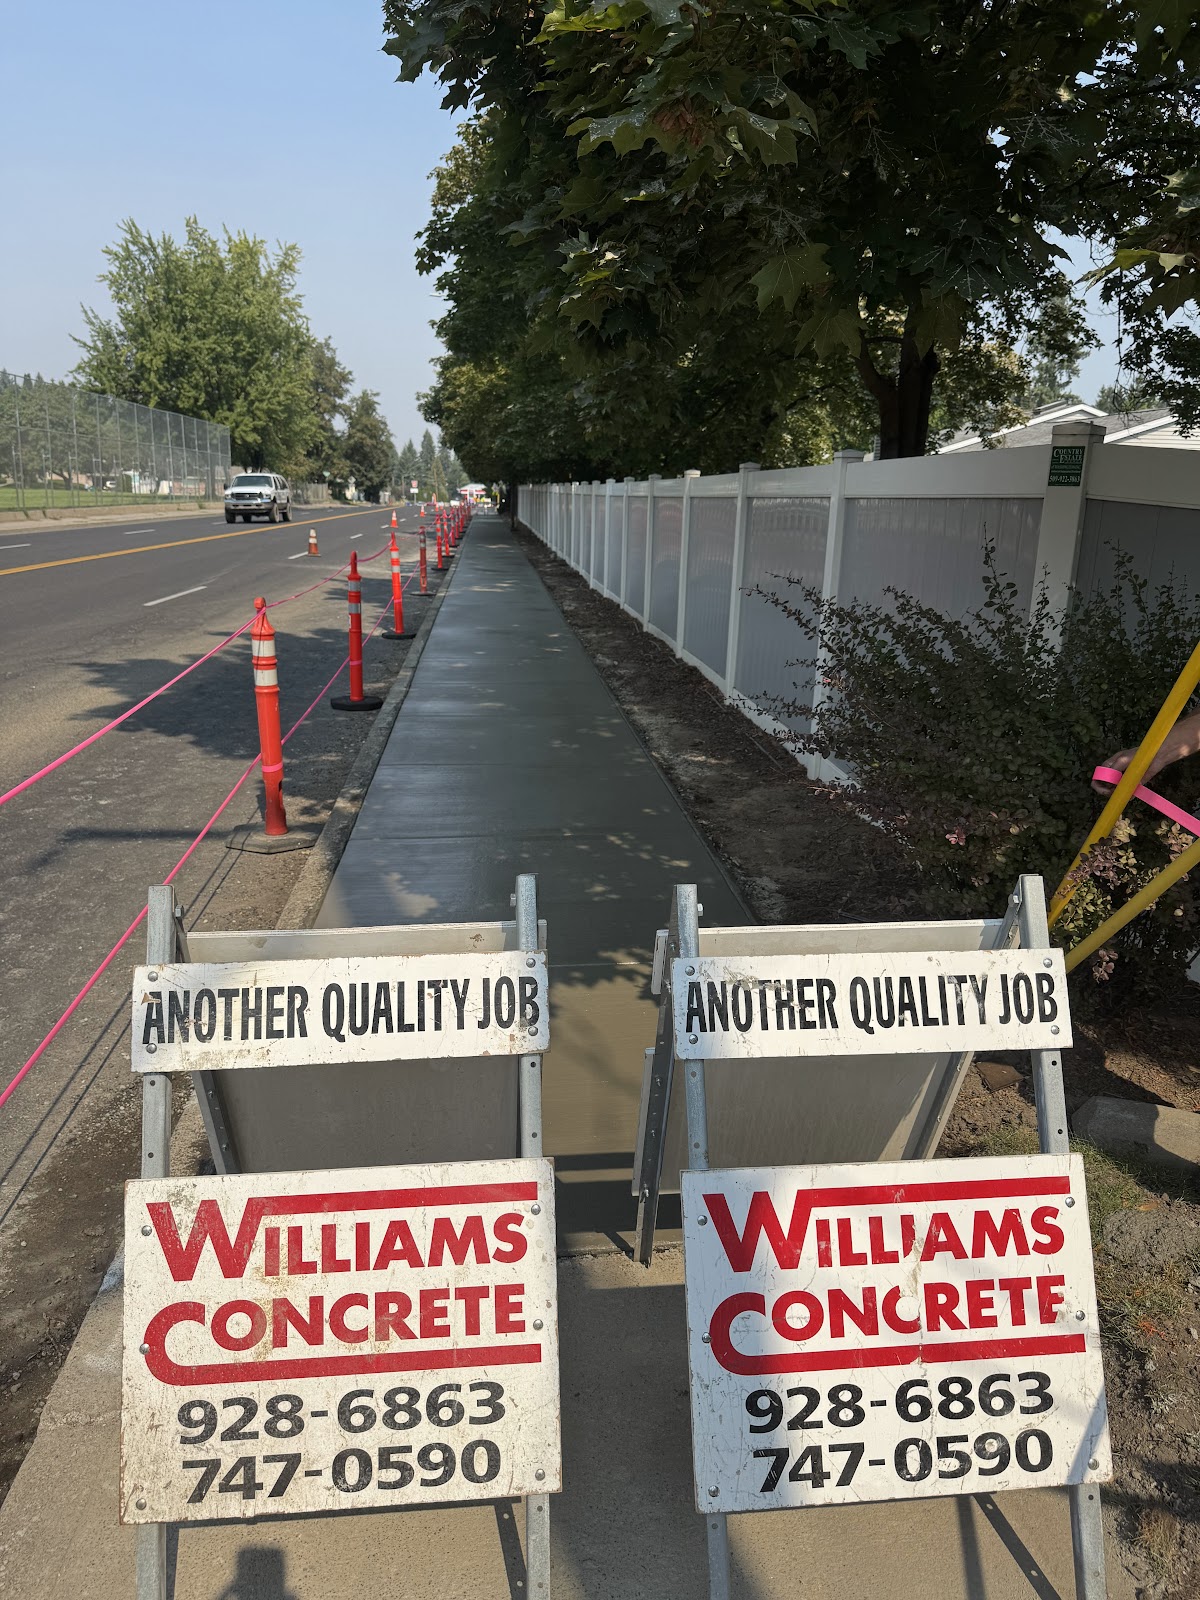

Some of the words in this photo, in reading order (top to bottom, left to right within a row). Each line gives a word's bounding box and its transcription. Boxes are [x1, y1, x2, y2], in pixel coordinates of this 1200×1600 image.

[1053, 449, 1083, 457] COUNTRY
[1060, 454, 1082, 463] ESTATE
[142, 985, 309, 1045] ANOTHER
[321, 978, 470, 1043] QUALITY
[476, 975, 541, 1030] JOB
[685, 977, 839, 1034] ANOTHER
[849, 974, 990, 1035] QUALITY
[998, 972, 1059, 1026] JOB
[145, 1196, 529, 1282] WILLIAMS
[702, 1188, 1066, 1273] WILLIAMS
[143, 1282, 526, 1386] CONCRETE
[709, 1274, 1067, 1376] CONCRETE
[176, 1380, 507, 1446] 928-6863
[744, 1371, 1054, 1434] 928-6863
[181, 1438, 502, 1505] 747-0590
[752, 1428, 1054, 1493] 747-0590
